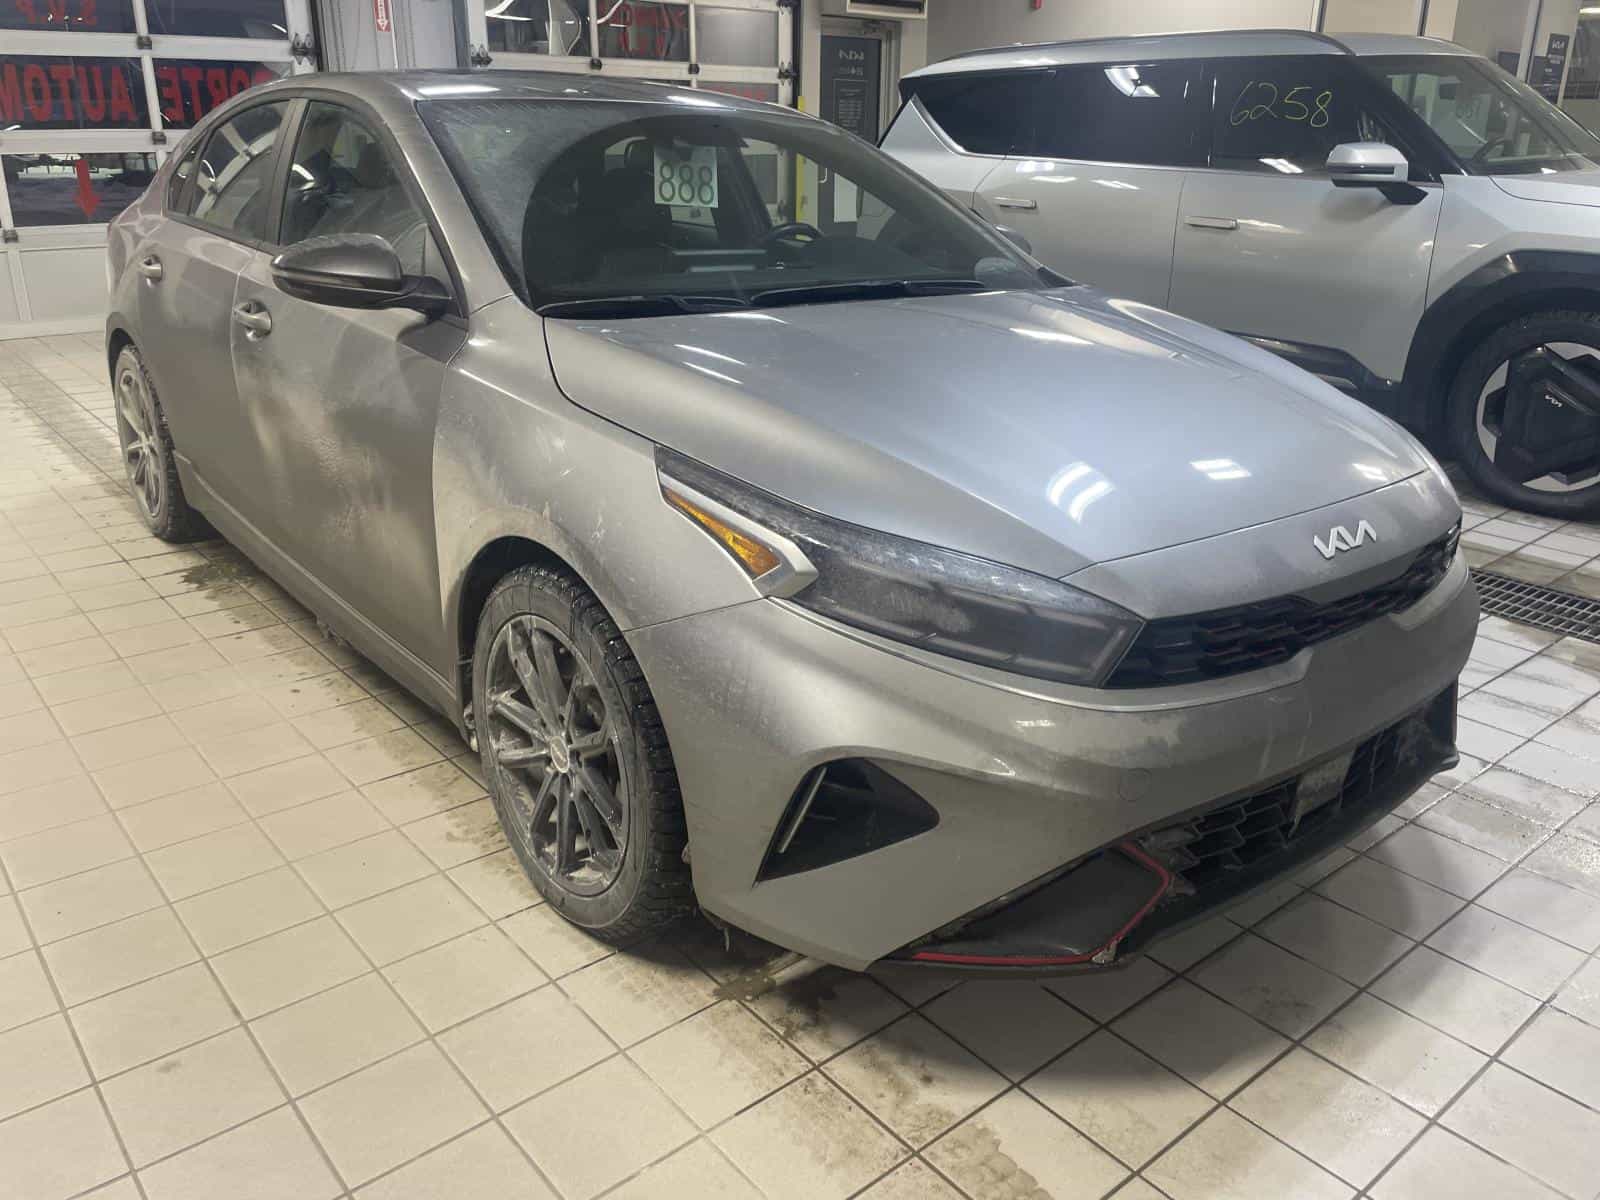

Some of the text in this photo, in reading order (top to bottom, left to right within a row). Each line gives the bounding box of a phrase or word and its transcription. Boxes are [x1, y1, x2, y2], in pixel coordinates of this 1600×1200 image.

[1230, 81, 1332, 128] 6258
[659, 162, 714, 205] 888
[1313, 520, 1377, 558] KIA
